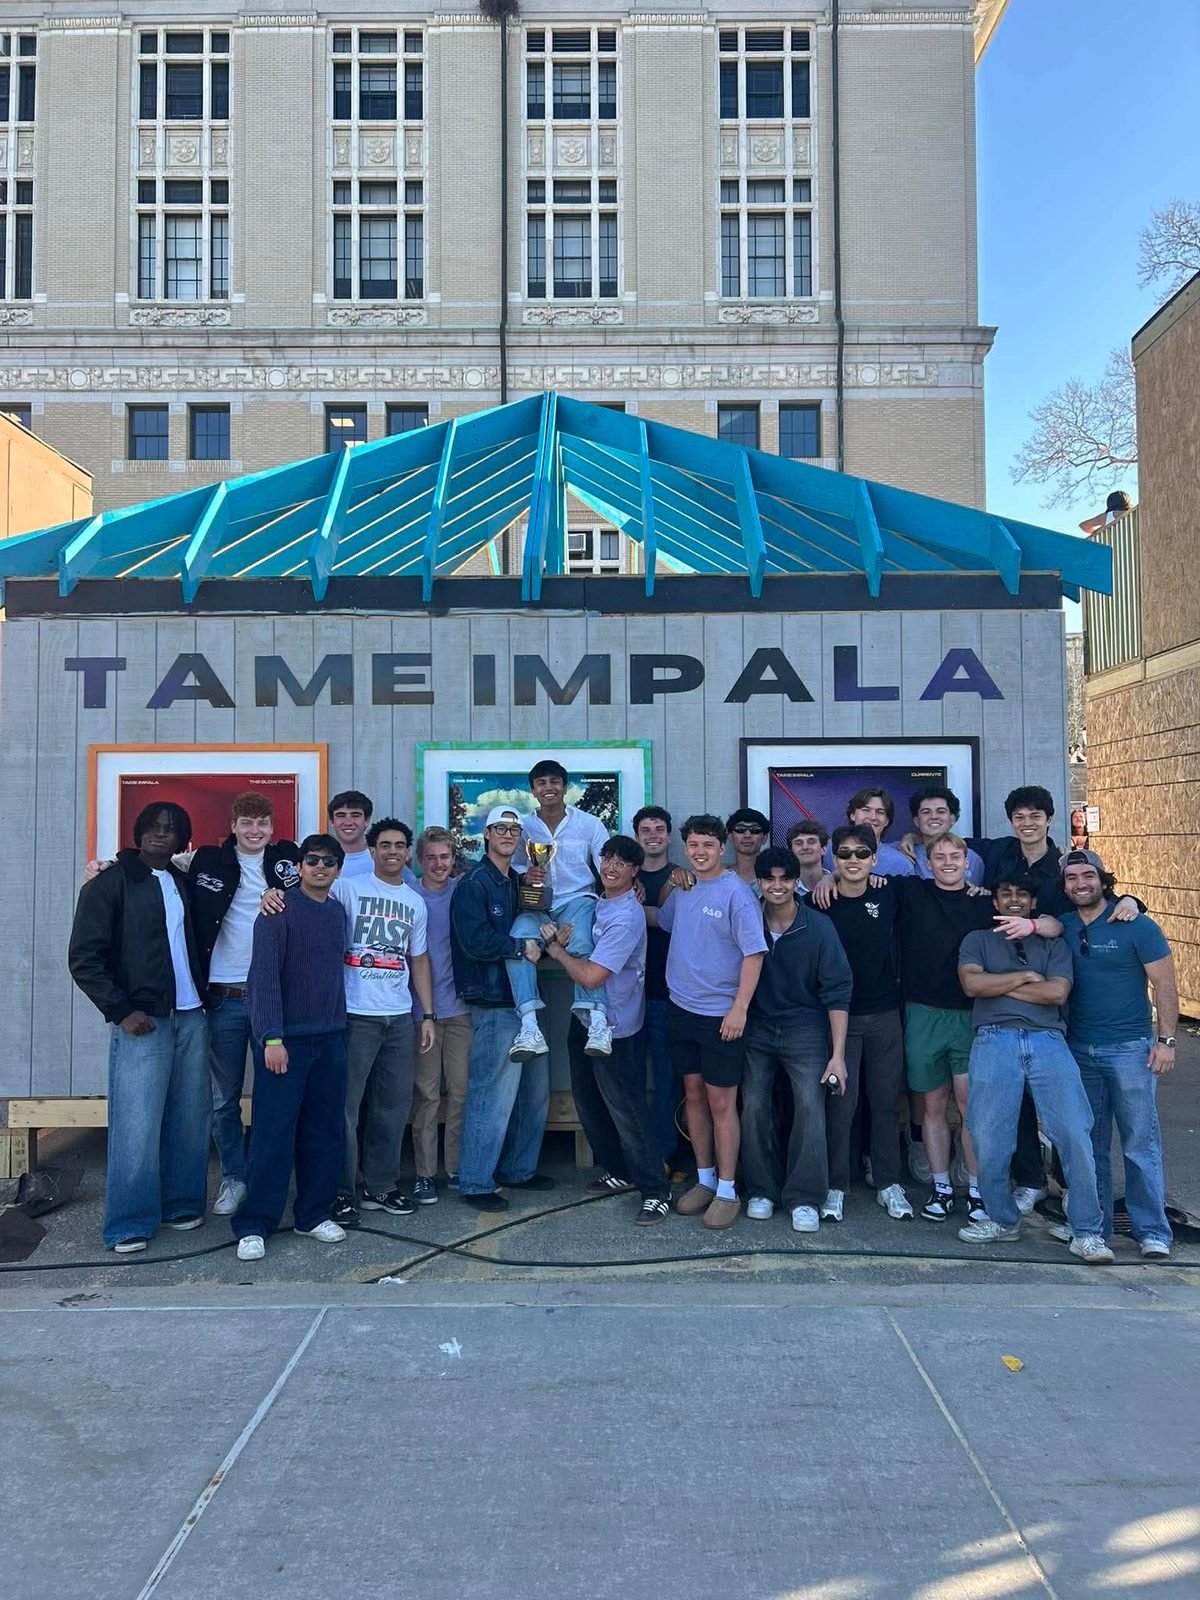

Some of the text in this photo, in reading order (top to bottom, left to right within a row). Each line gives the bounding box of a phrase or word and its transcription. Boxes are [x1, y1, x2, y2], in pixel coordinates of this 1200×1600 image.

[65, 645, 1005, 708] TAME IMPALA
[358, 896, 416, 925] THINK
[353, 915, 414, 946] FAST
